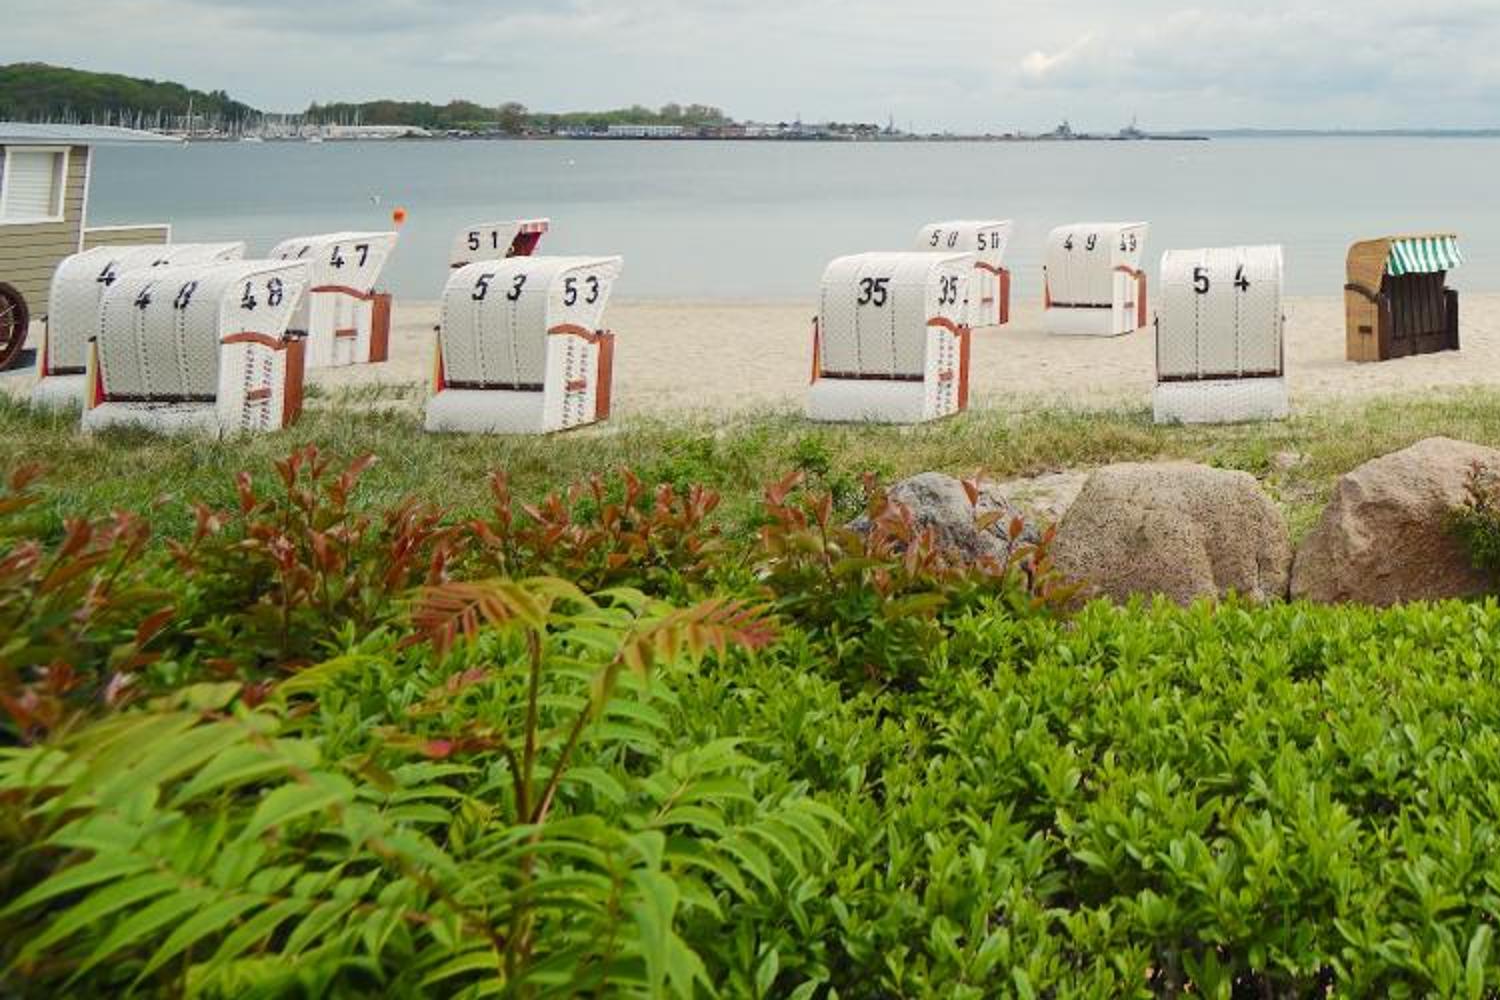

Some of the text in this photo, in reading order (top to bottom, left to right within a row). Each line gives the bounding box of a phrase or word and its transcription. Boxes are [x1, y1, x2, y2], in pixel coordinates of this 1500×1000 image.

[467, 230, 498, 252] 51
[929, 229, 959, 249] 50
[1063, 233, 1097, 252] 49
[329, 243, 369, 269] 47
[240, 277, 283, 311] 48
[471, 273, 527, 302] 53
[563, 275, 599, 307] 53
[857, 277, 891, 309] 35
[938, 275, 959, 306] 35
[1193, 264, 1251, 295] 54
